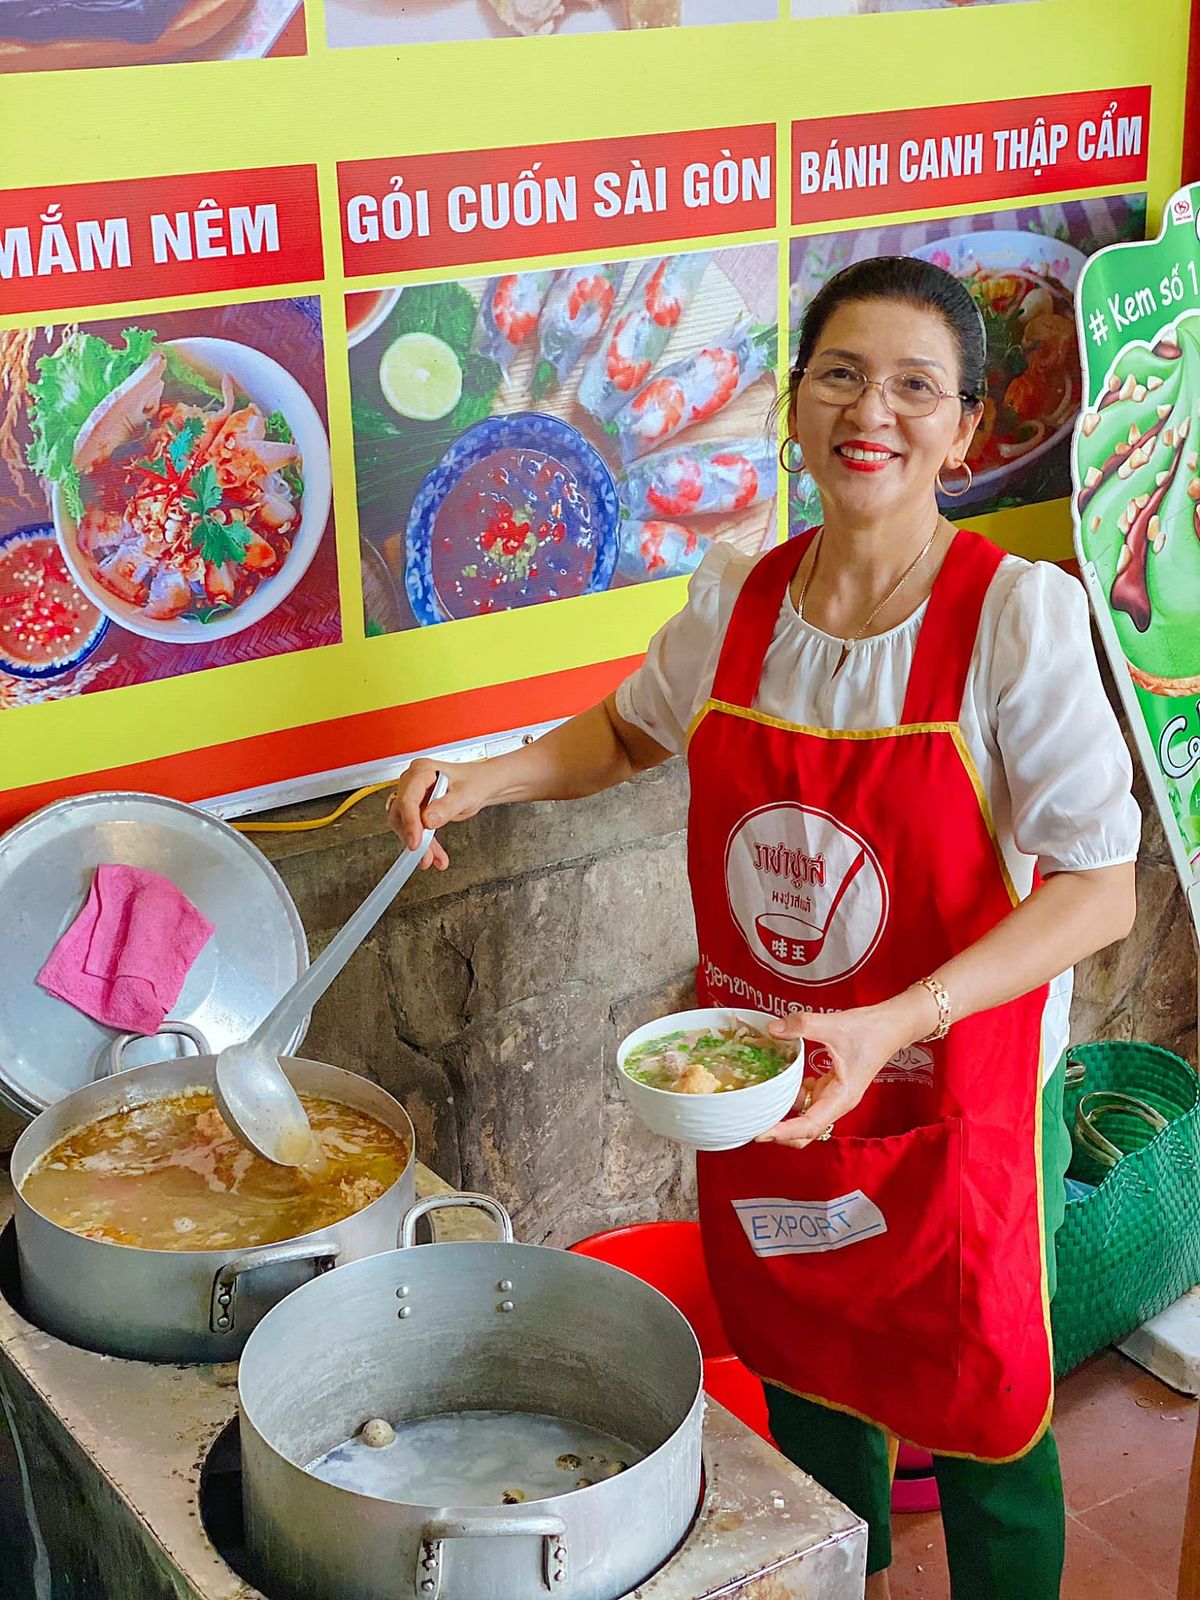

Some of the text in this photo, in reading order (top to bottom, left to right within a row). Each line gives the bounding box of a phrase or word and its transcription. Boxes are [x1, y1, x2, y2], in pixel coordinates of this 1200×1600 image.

[800, 101, 1142, 195] BÁNH CANH THẬP CẨM
[346, 149, 771, 243] GỎI CUỐN SÀI GÒN
[0, 198, 280, 279] MẮM NÊM
[1107, 287, 1157, 332] Kem
[1159, 263, 1184, 306] số
[752, 1210, 852, 1240] EXPORT
